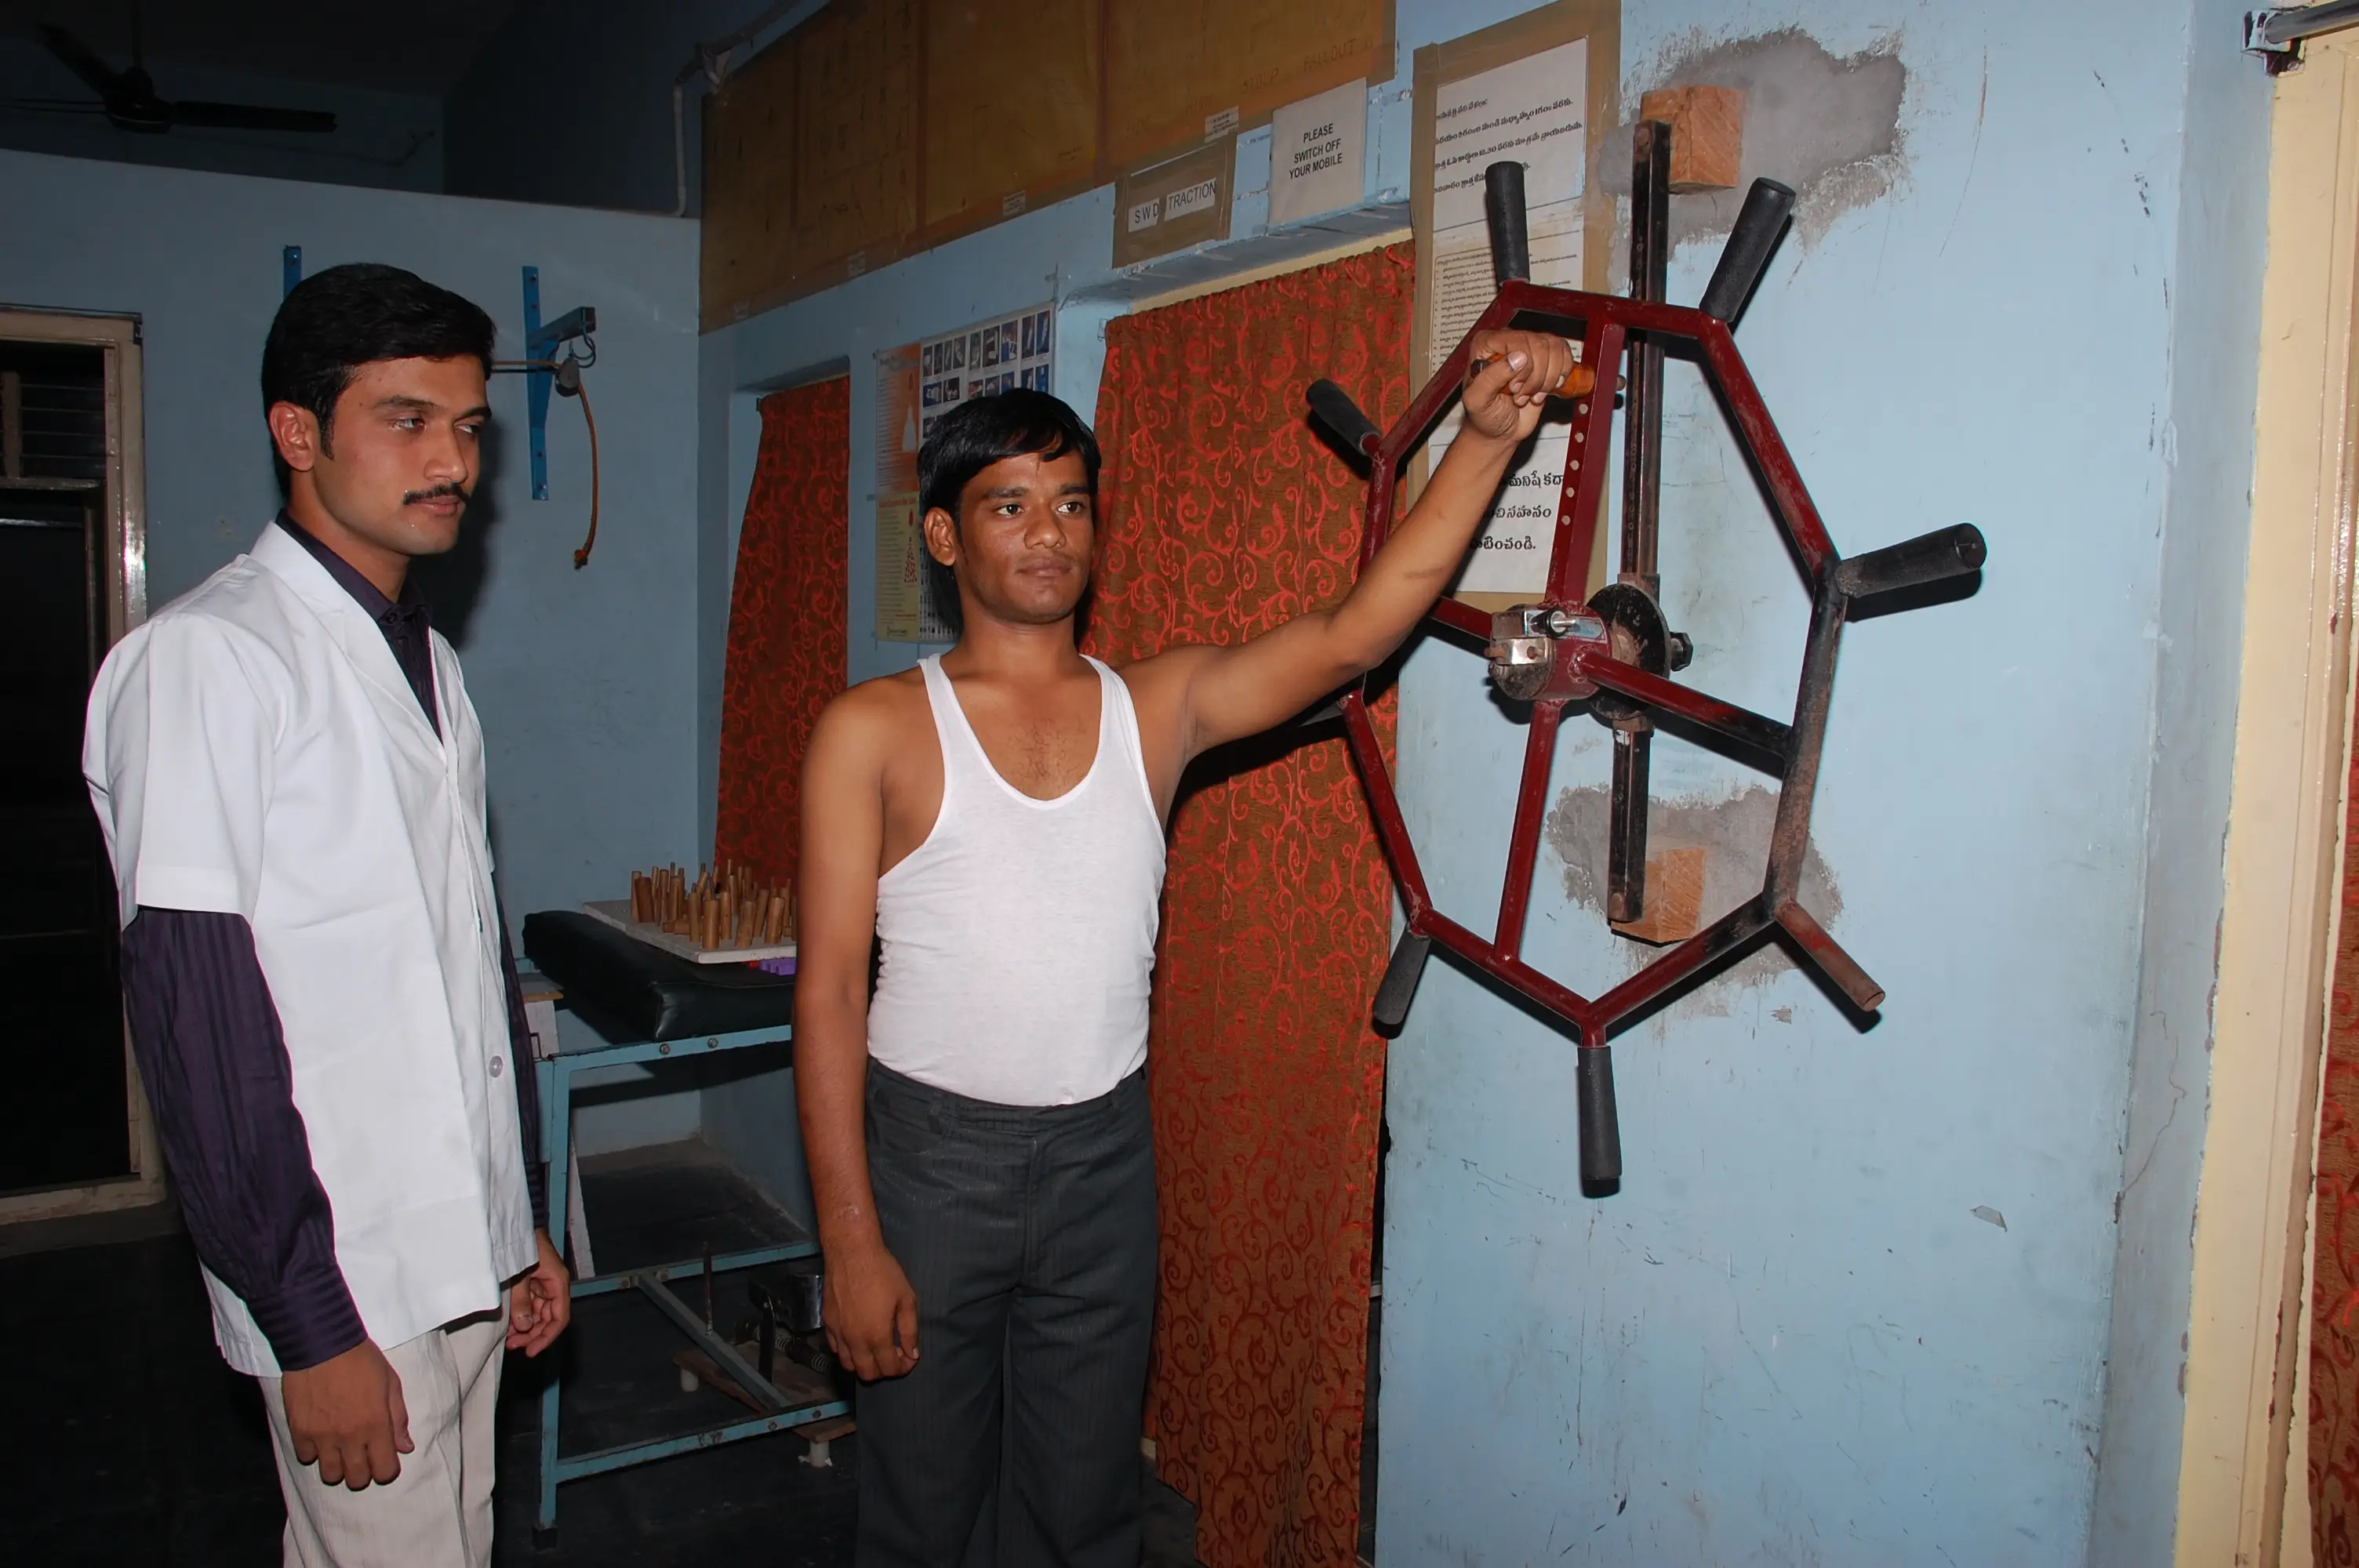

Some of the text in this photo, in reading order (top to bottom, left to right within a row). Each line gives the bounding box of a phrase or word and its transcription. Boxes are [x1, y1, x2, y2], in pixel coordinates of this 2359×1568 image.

[1303, 123, 1334, 143] PLEASE
[1293, 137, 1342, 164] SWITCH OFF
[1289, 152, 1343, 180] YOUR MOBILE
[1168, 181, 1216, 211] TRACTION
